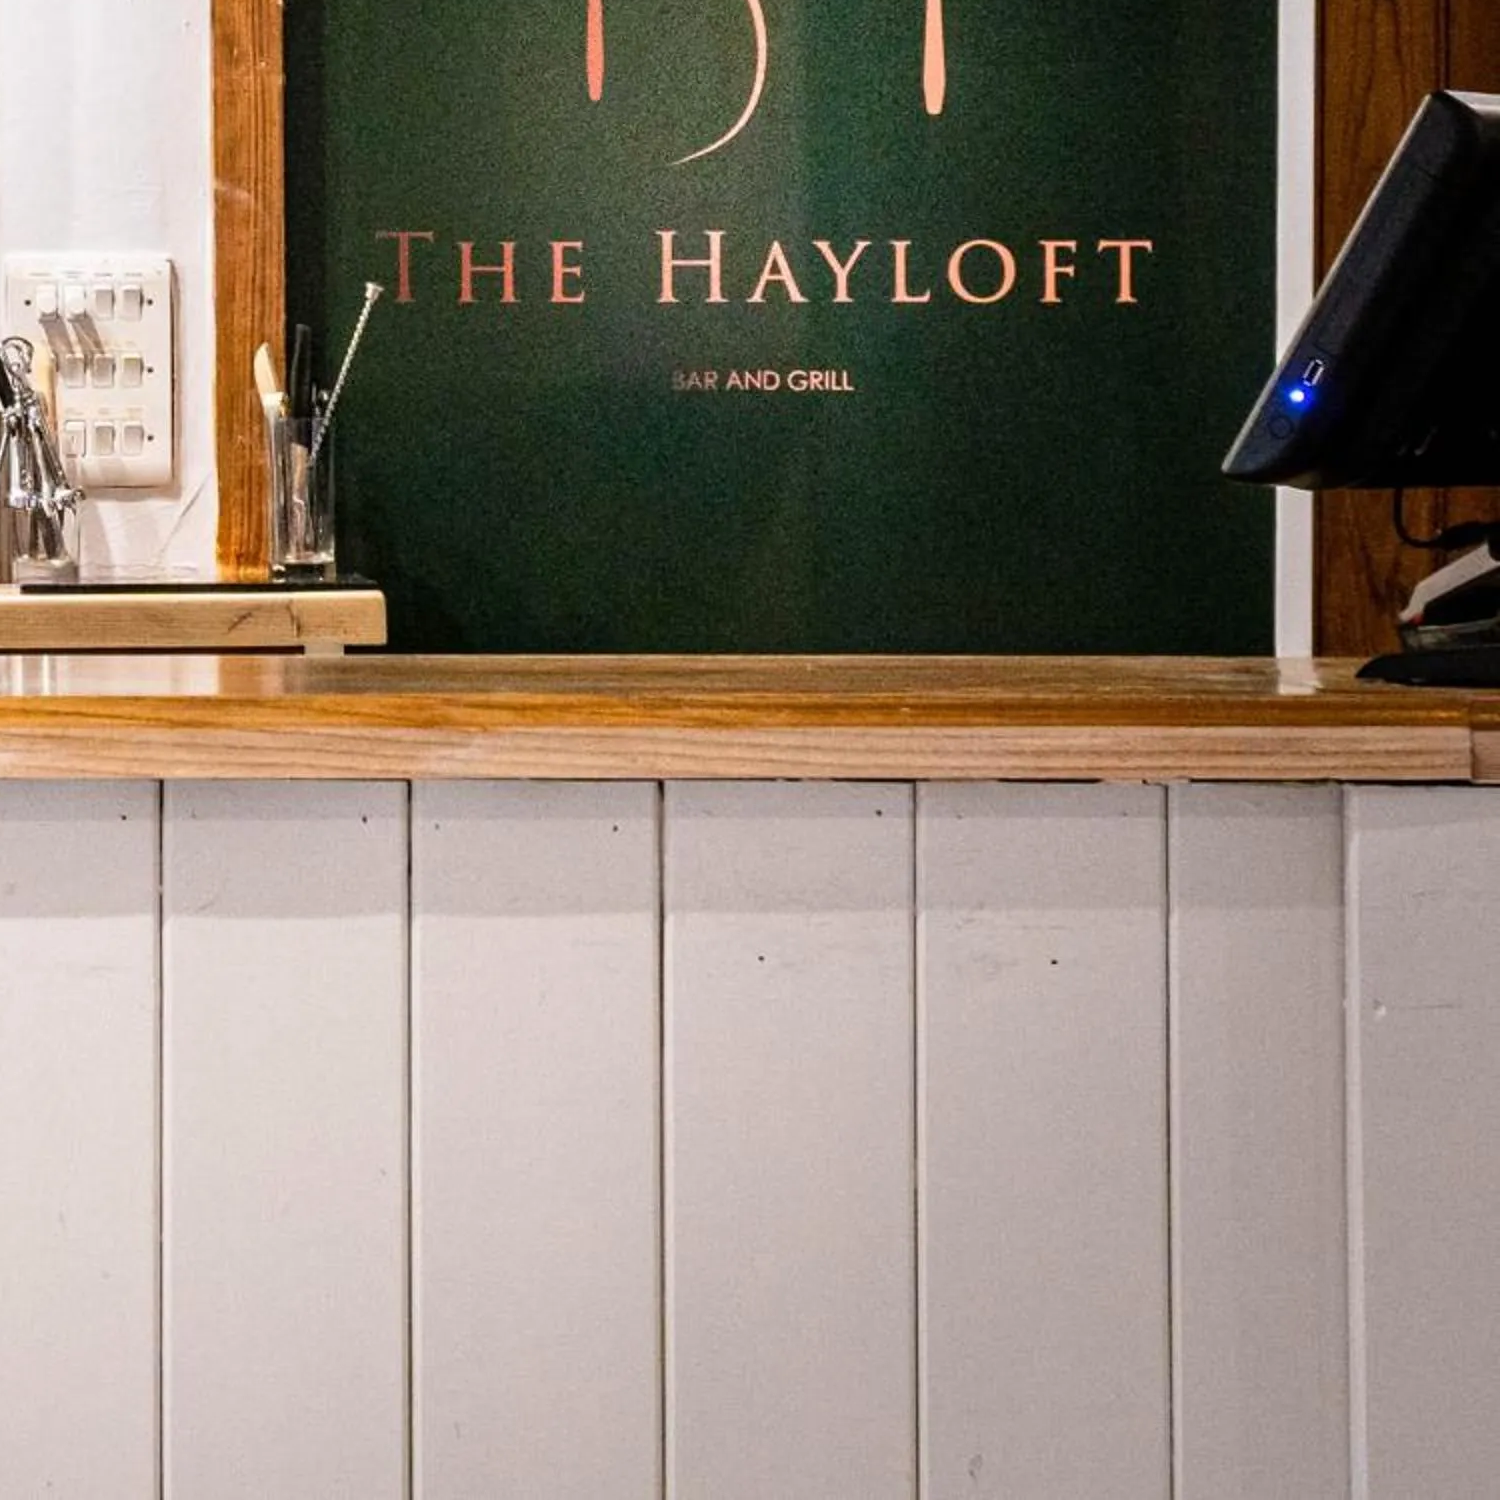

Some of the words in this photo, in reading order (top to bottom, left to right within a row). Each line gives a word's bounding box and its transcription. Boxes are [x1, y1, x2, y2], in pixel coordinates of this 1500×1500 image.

[375, 230, 586, 304] THE
[655, 229, 1154, 304] HAYLOFT
[672, 371, 719, 391] BAR
[726, 370, 780, 391] AND
[787, 370, 855, 391] GRILL
